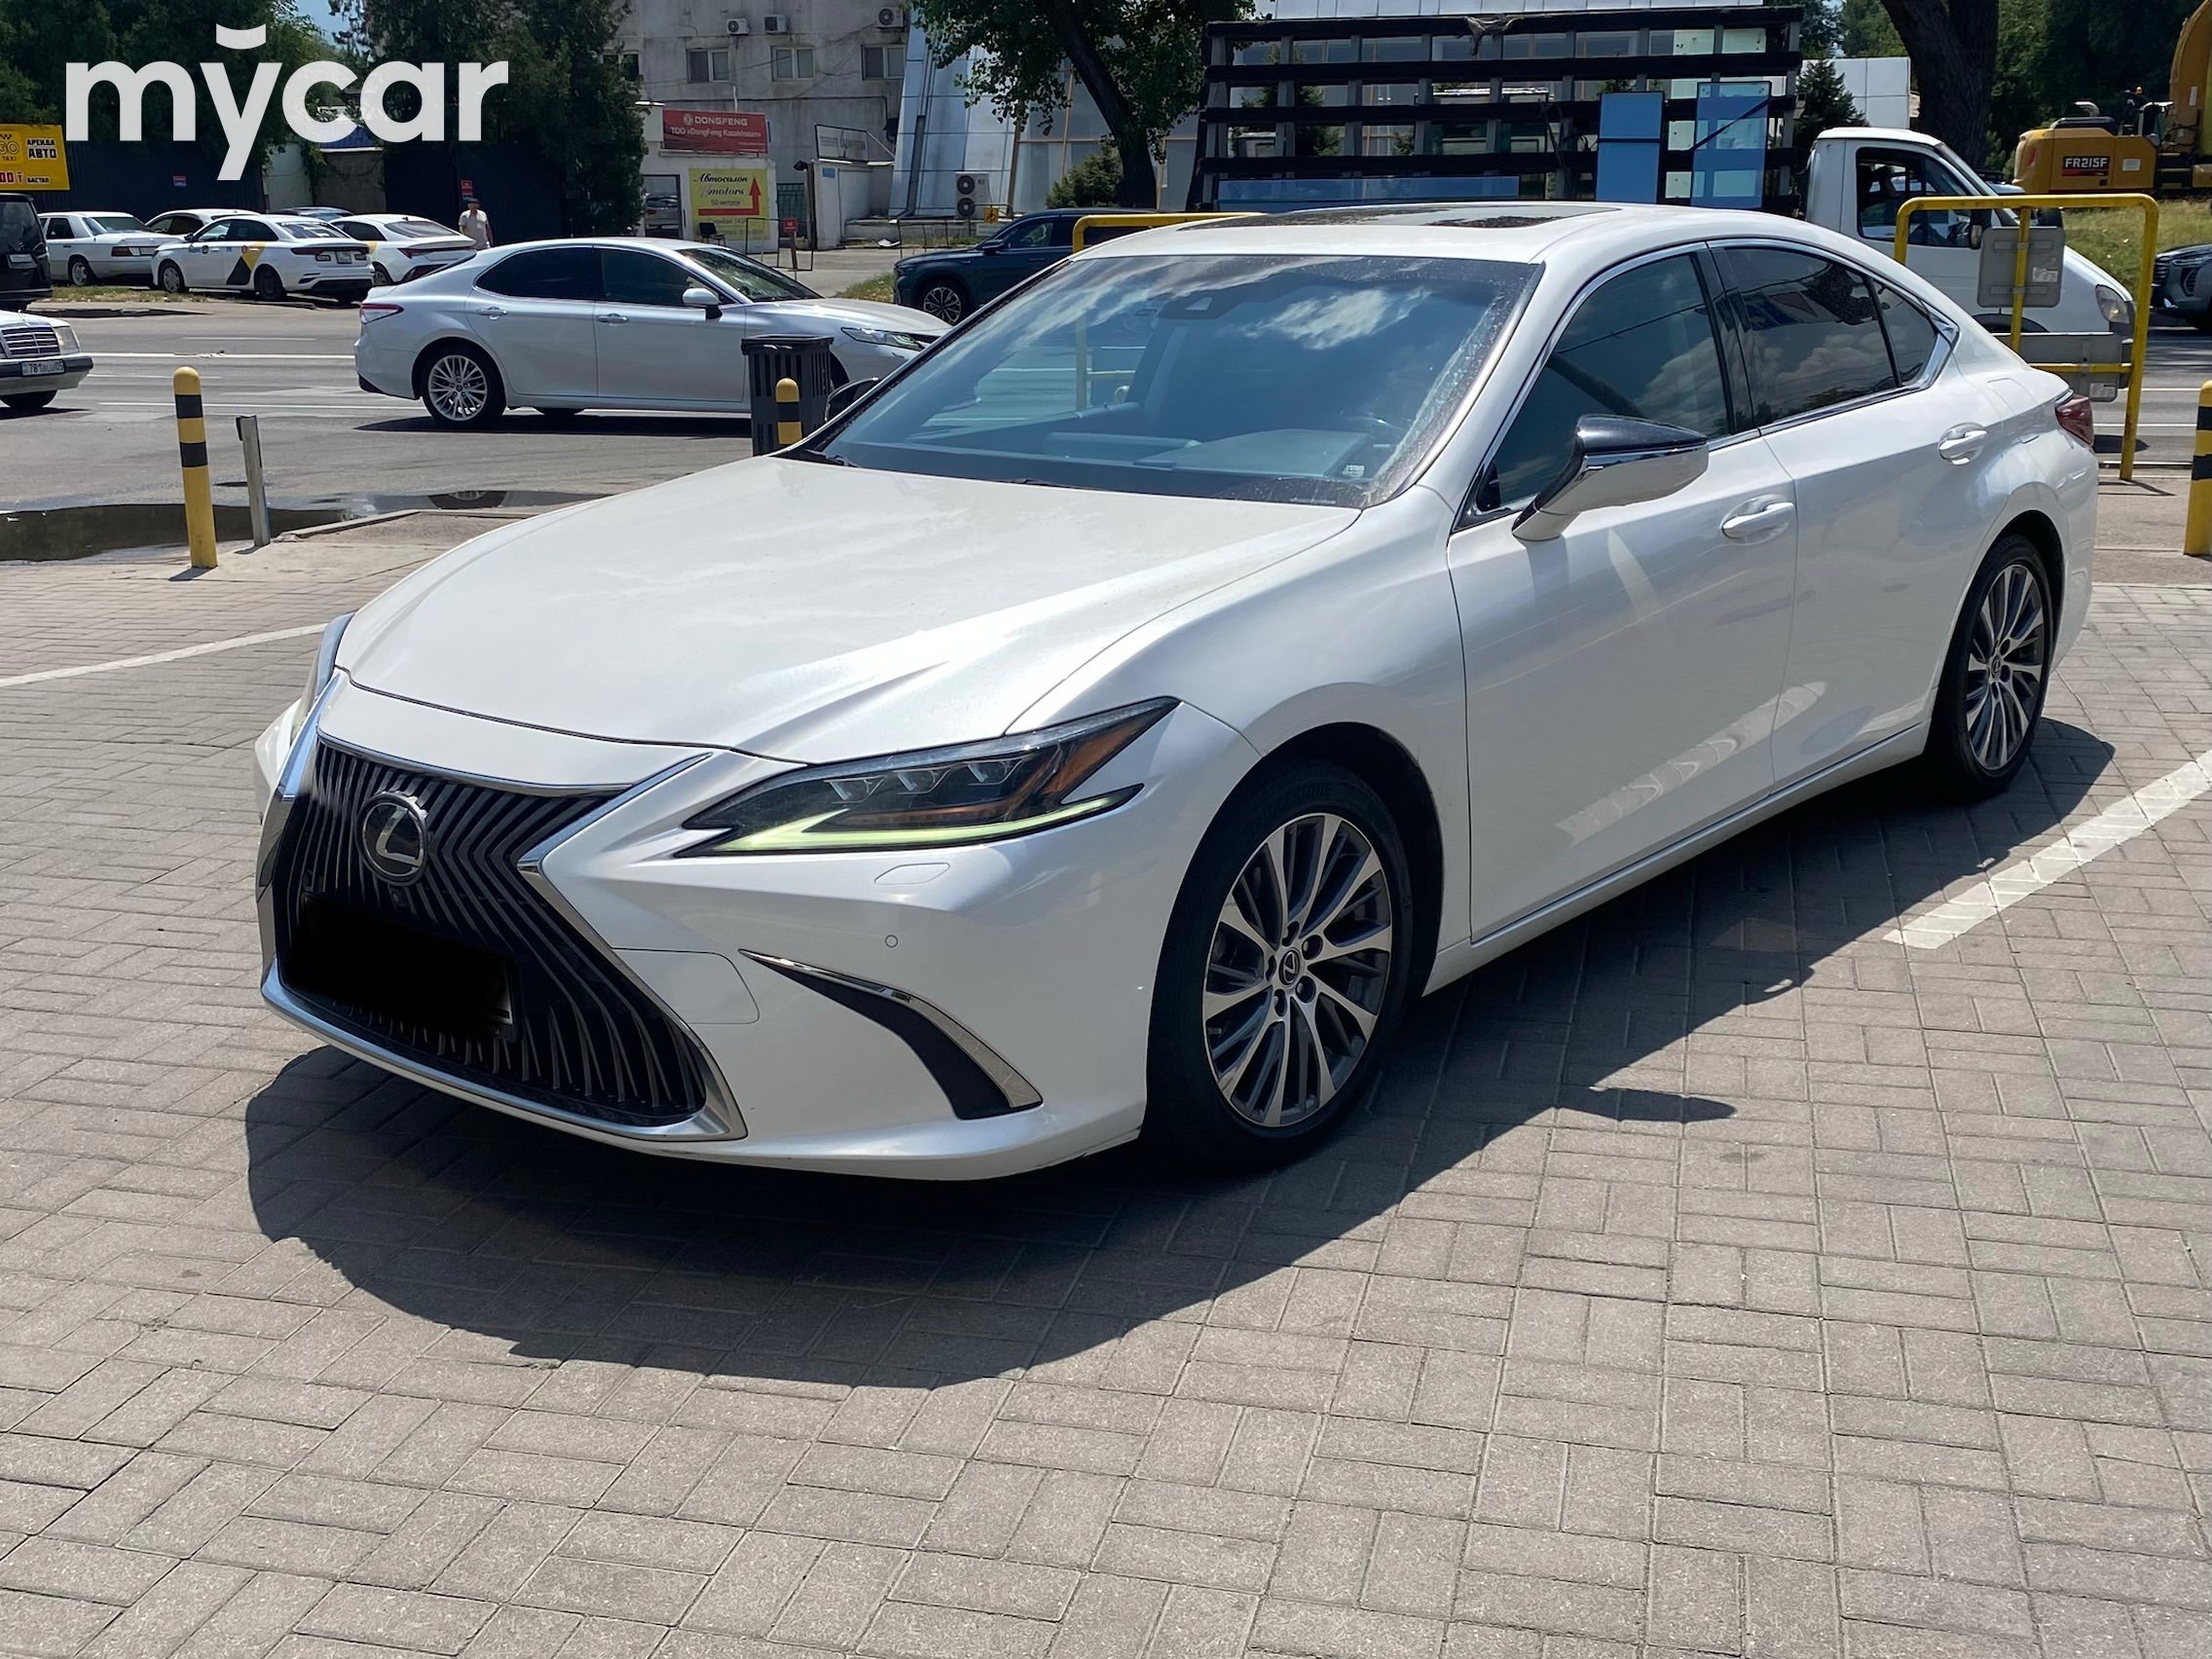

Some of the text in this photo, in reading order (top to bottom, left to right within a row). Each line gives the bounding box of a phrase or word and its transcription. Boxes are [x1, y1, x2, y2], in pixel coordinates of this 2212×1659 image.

[694, 116, 749, 127] DONGFENG
[28, 148, 57, 158] АВТО
[2065, 157, 2108, 168] FR215F
[693, 172, 748, 183] Автосалон
